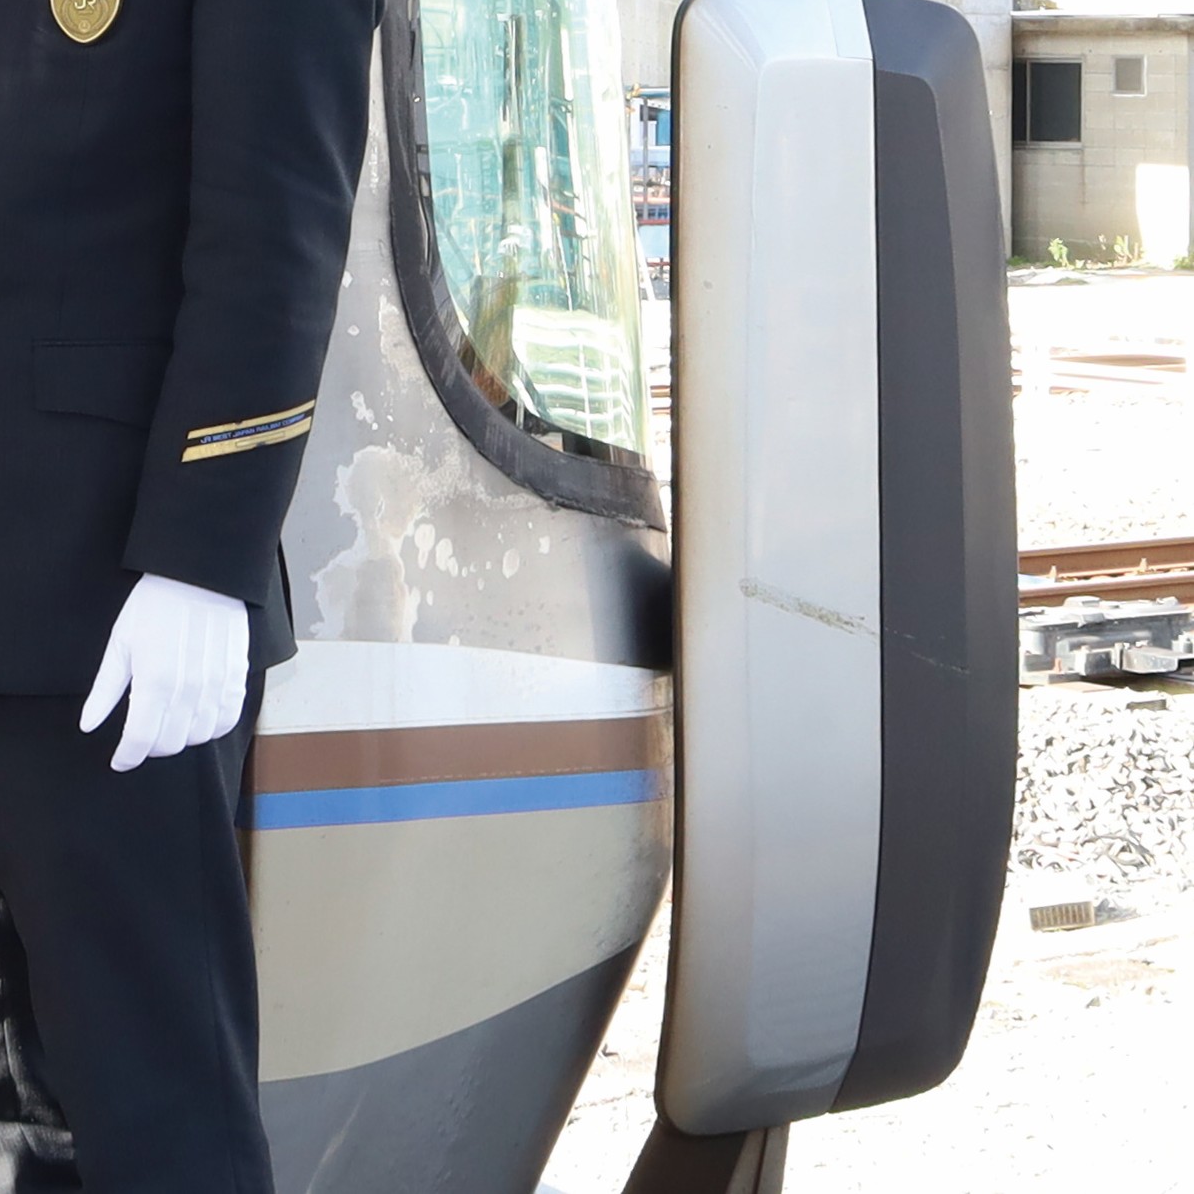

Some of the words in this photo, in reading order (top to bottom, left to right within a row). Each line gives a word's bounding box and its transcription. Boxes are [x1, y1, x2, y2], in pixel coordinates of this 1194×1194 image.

[200, 435, 212, 444] JR
[212, 432, 233, 443] WEST
[233, 428, 256, 438] JAPAN
[256, 421, 282, 433] RAILWAY
